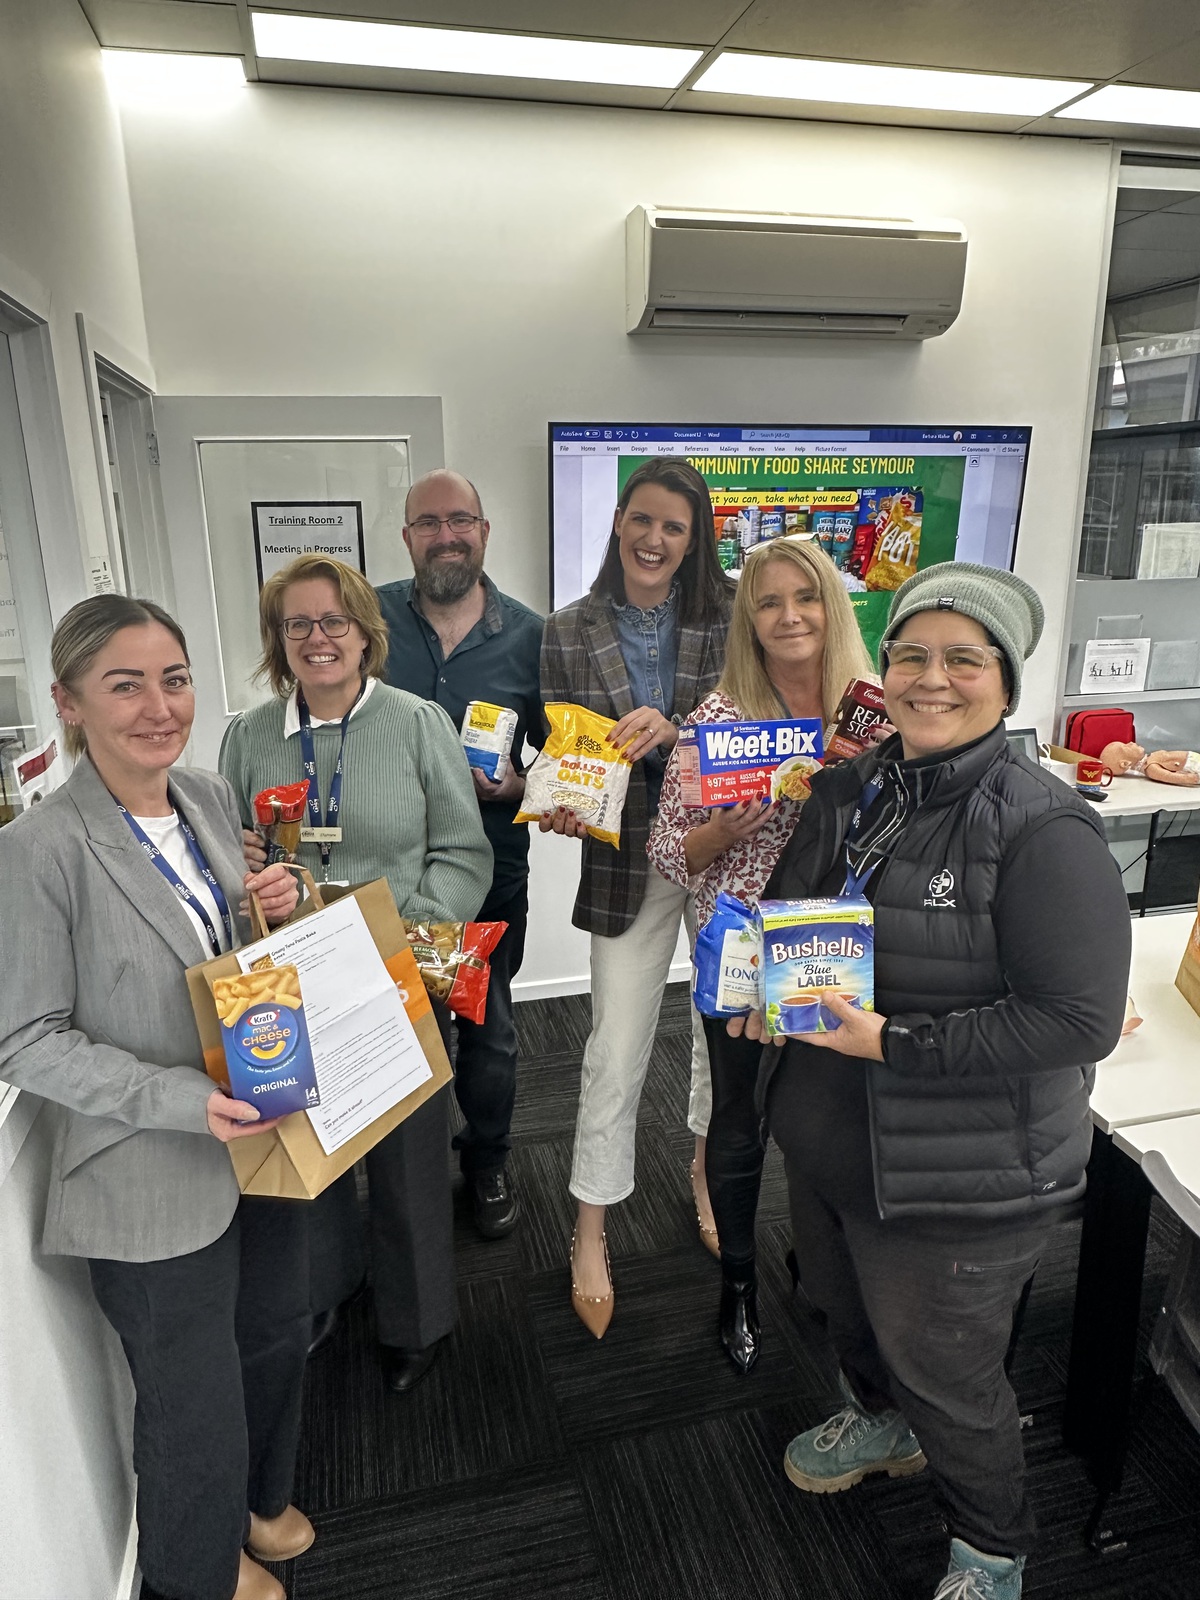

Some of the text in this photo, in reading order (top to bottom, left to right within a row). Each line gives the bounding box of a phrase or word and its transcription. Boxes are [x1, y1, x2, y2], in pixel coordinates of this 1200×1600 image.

[686, 457, 914, 474] OMMUNITY FOOD SHARE SEYMOUR
[723, 496, 739, 505] you
[742, 496, 760, 504] can,
[765, 494, 784, 502] take
[788, 494, 809, 503] what
[813, 496, 828, 504] you
[831, 494, 853, 503] need.
[269, 516, 306, 525] Training
[264, 545, 302, 554] Meeting
[314, 545, 352, 554] Progress
[706, 727, 818, 759] Weet-Bix
[557, 769, 604, 789] OATS
[771, 936, 864, 964] Bushells
[803, 964, 831, 975] Blue
[798, 974, 841, 988] LABEL
[254, 1014, 272, 1023] Kraft
[252, 1025, 271, 1034] mac
[253, 1077, 298, 1094] ORIGINAL
